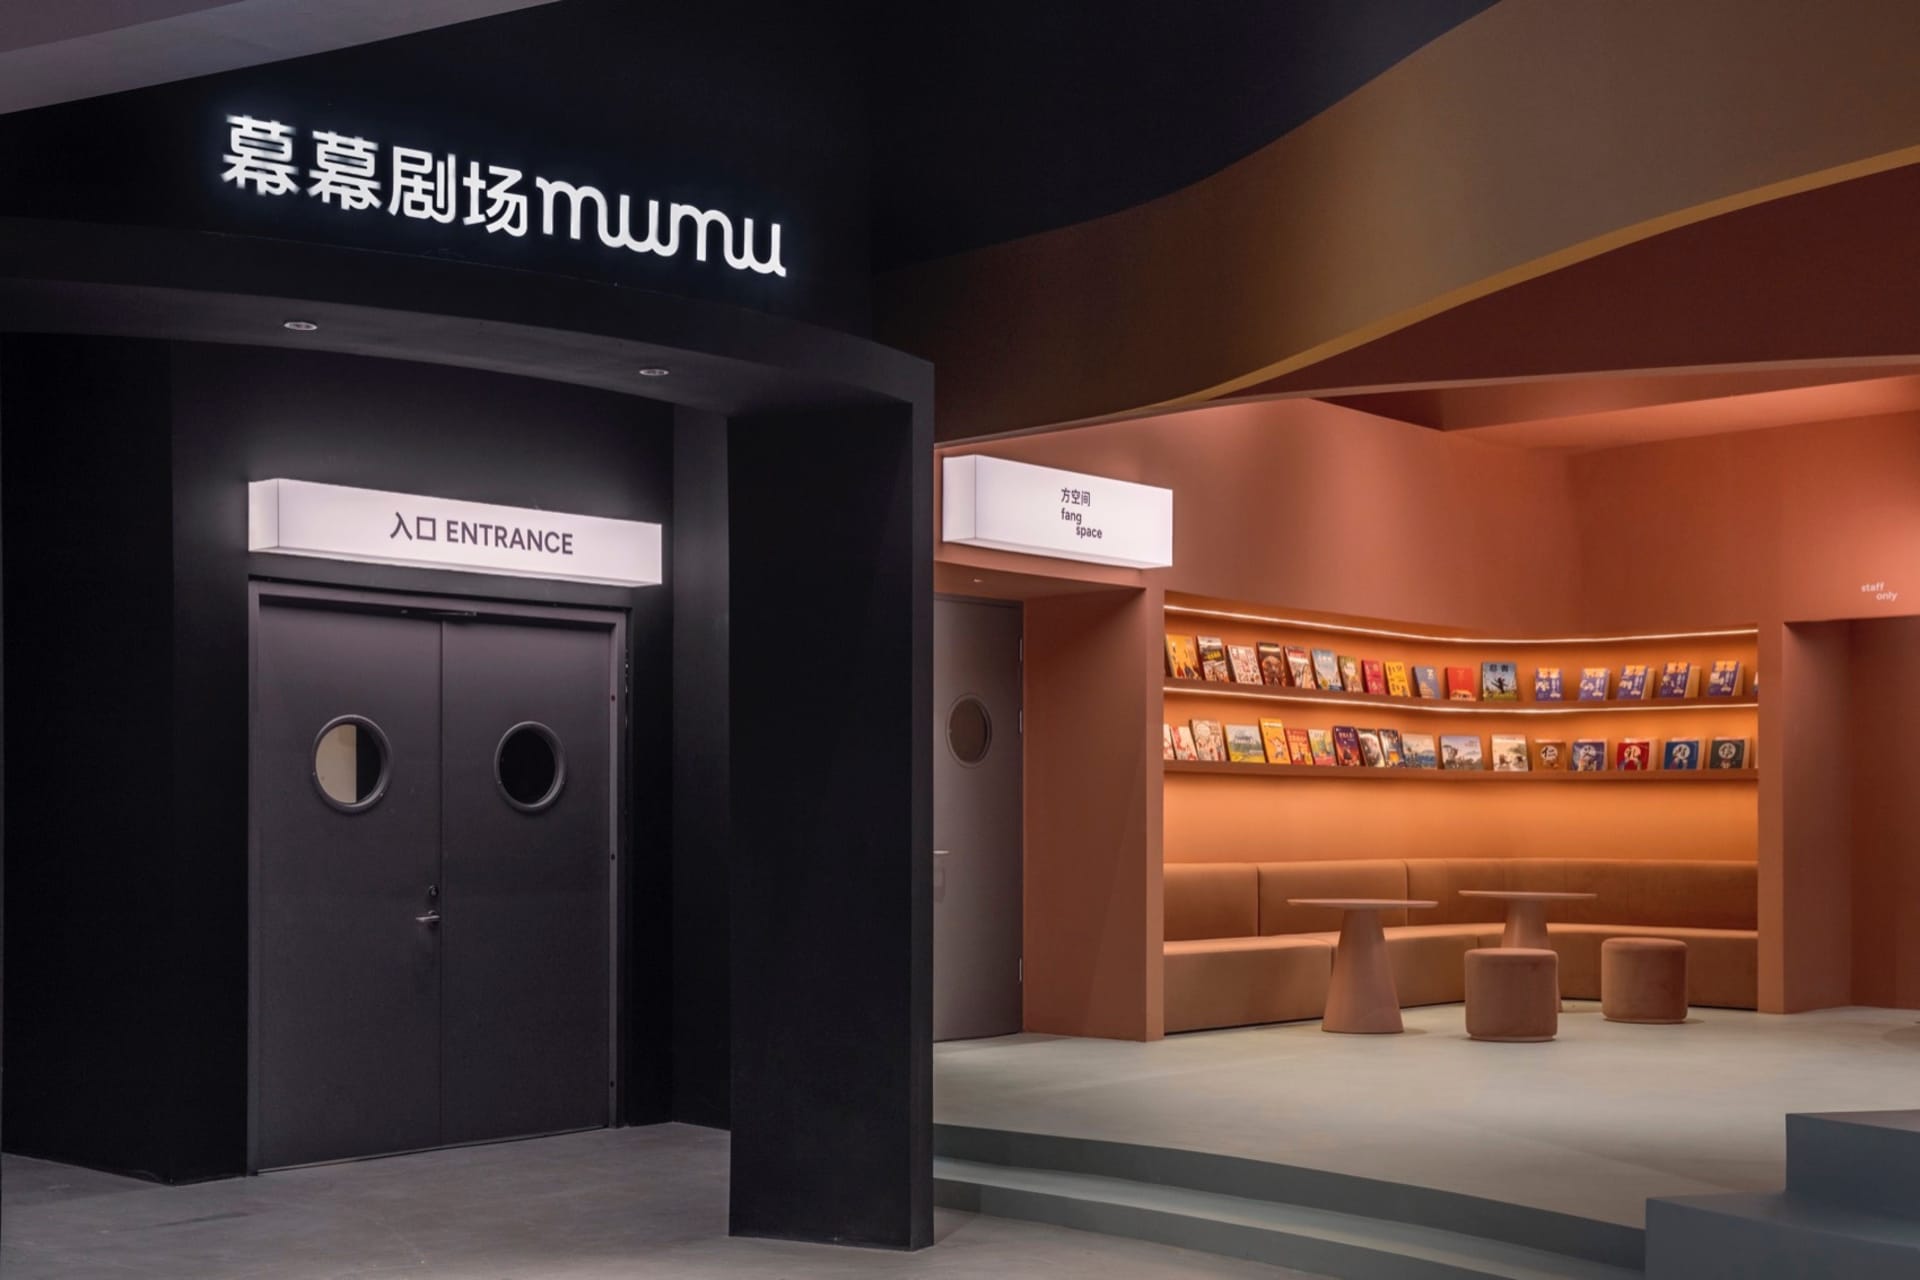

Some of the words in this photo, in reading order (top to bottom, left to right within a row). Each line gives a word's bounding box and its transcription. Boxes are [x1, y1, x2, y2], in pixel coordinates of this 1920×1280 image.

[221, 114, 528, 237] 幕幕剧场
[536, 175, 787, 277] mumu
[1061, 488, 1091, 506] 方空间
[1061, 507, 1082, 525] fang
[390, 511, 436, 542] 入口
[446, 520, 573, 555] ENTRANCE
[1076, 526, 1103, 539] space
[1861, 582, 1885, 592] staff
[1876, 591, 1898, 602] only
